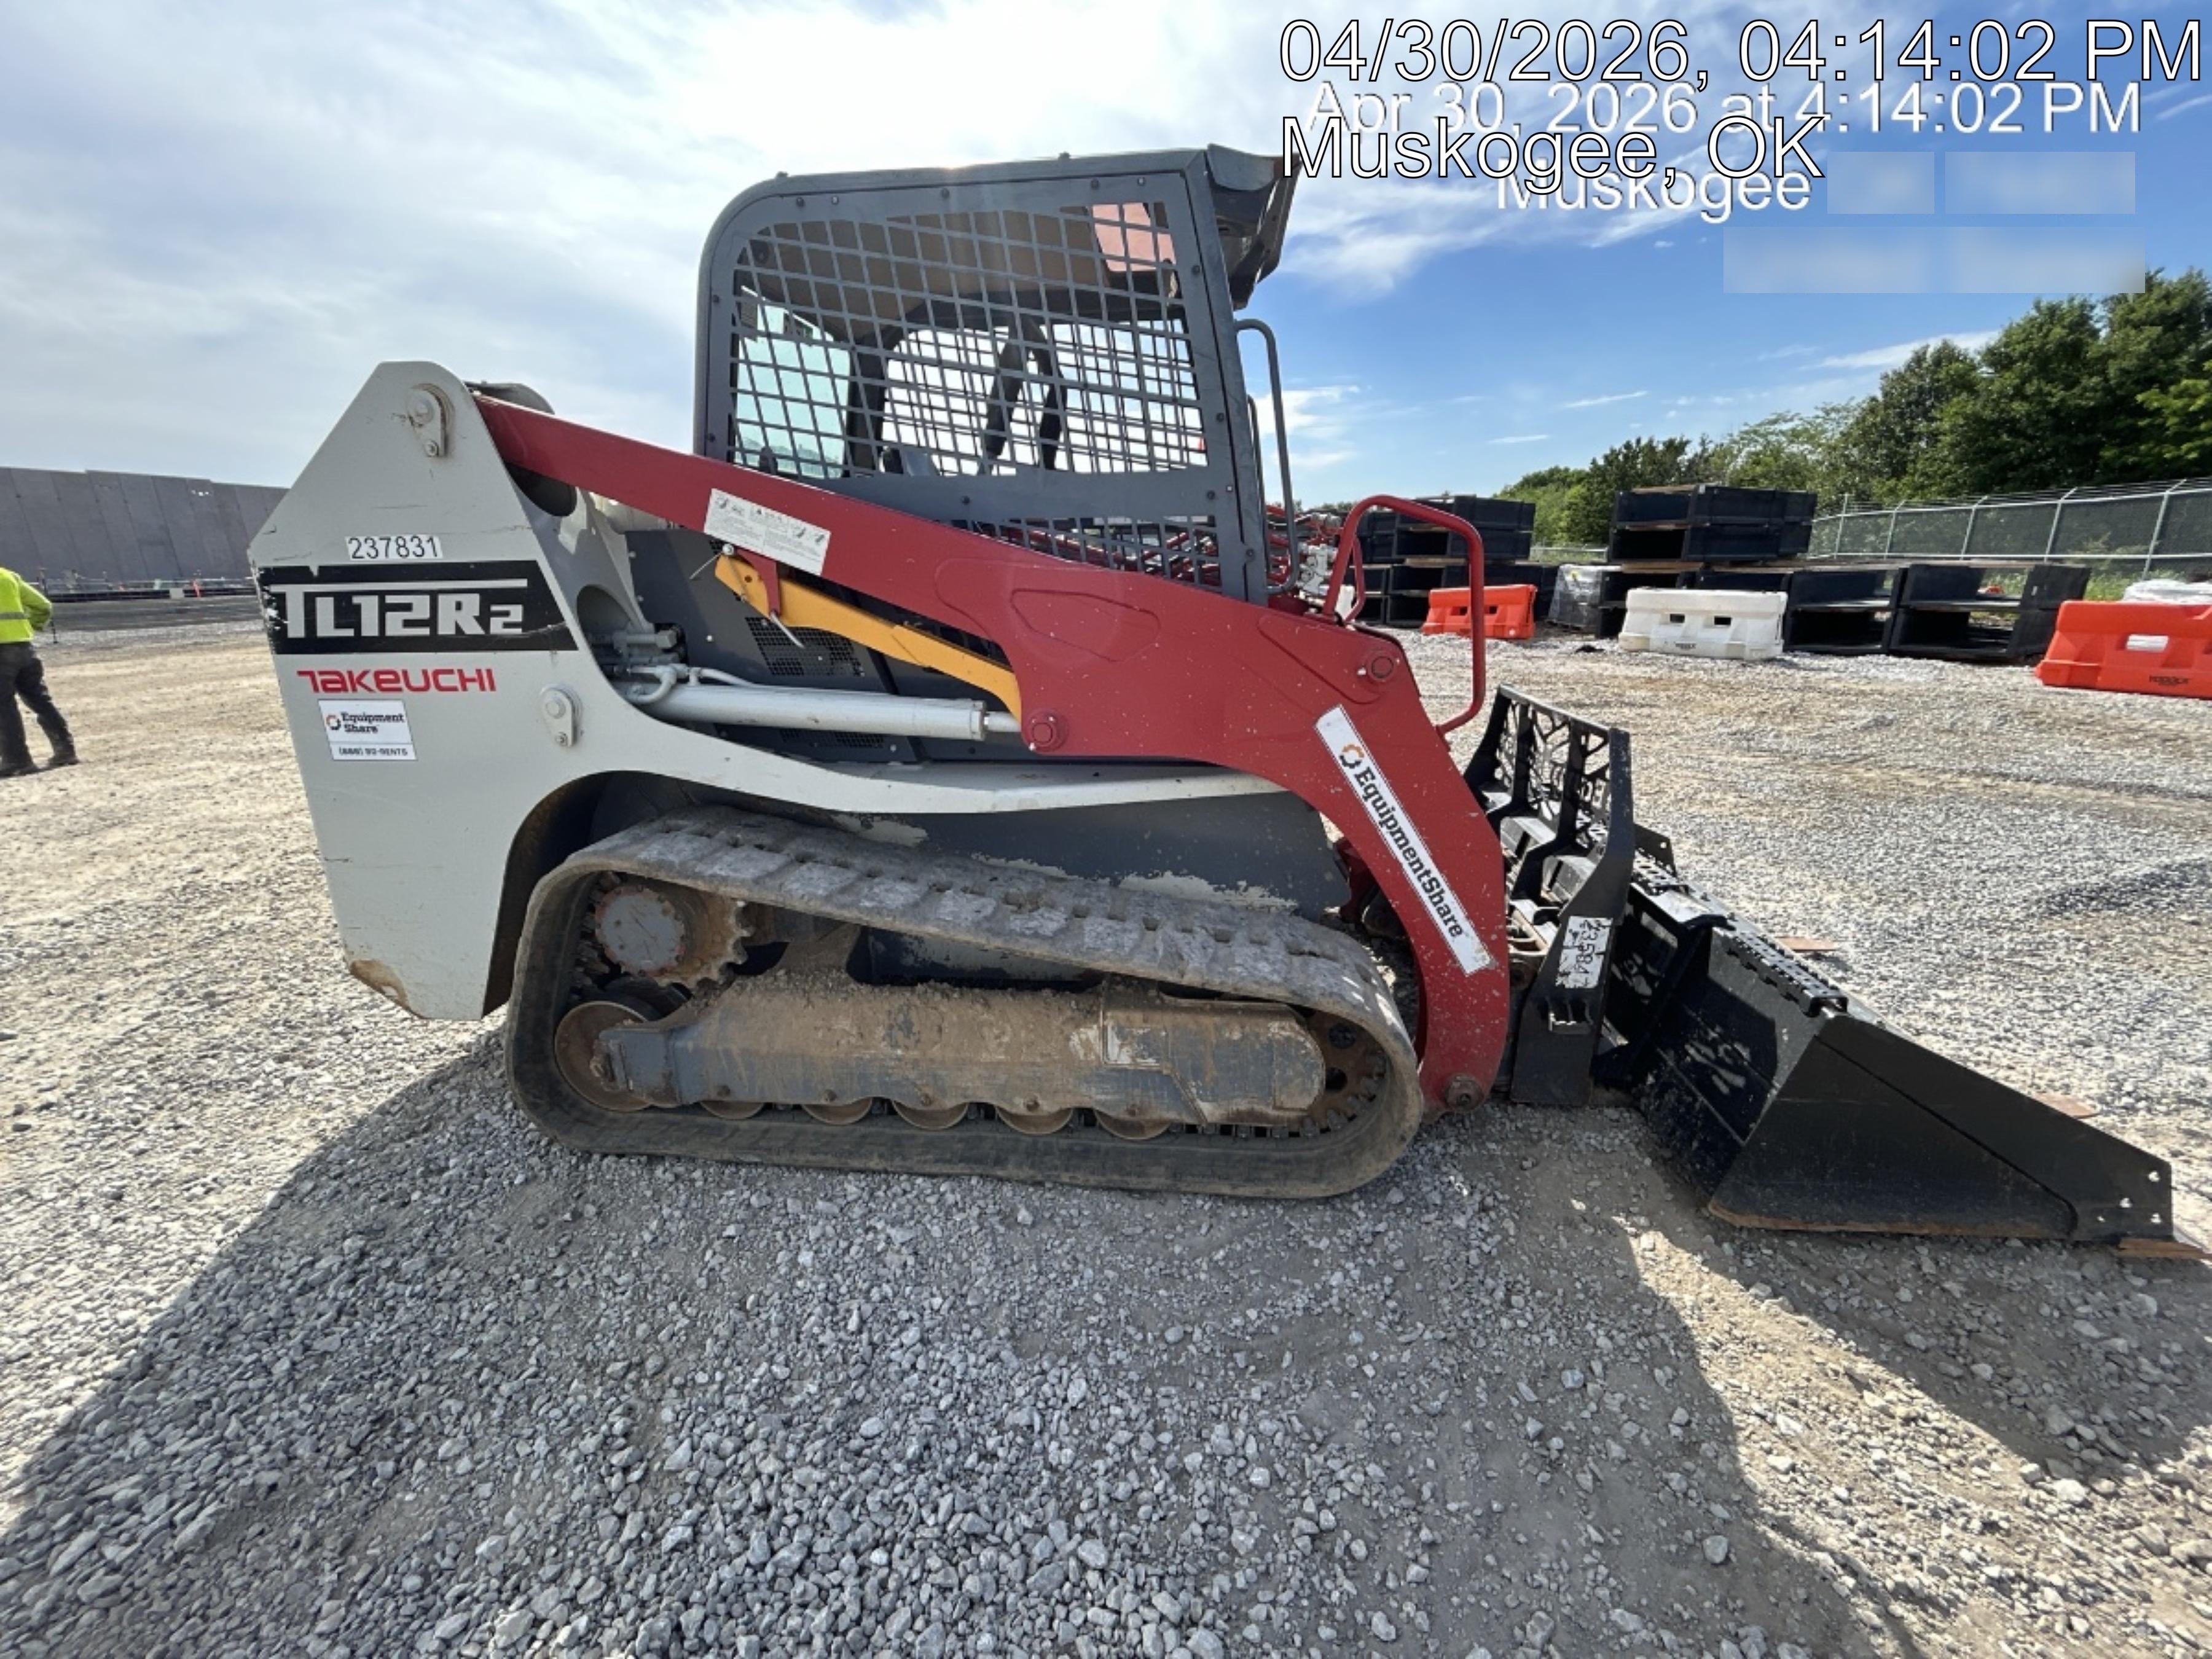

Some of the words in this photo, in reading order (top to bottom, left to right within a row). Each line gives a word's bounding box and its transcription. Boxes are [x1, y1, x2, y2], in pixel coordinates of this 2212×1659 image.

[348, 536, 439, 559] 237831
[296, 668, 497, 694] TAKEUCHI
[340, 710, 405, 723] Equipment
[343, 723, 378, 734] Share
[1354, 767, 1464, 938] EquipmentShare
